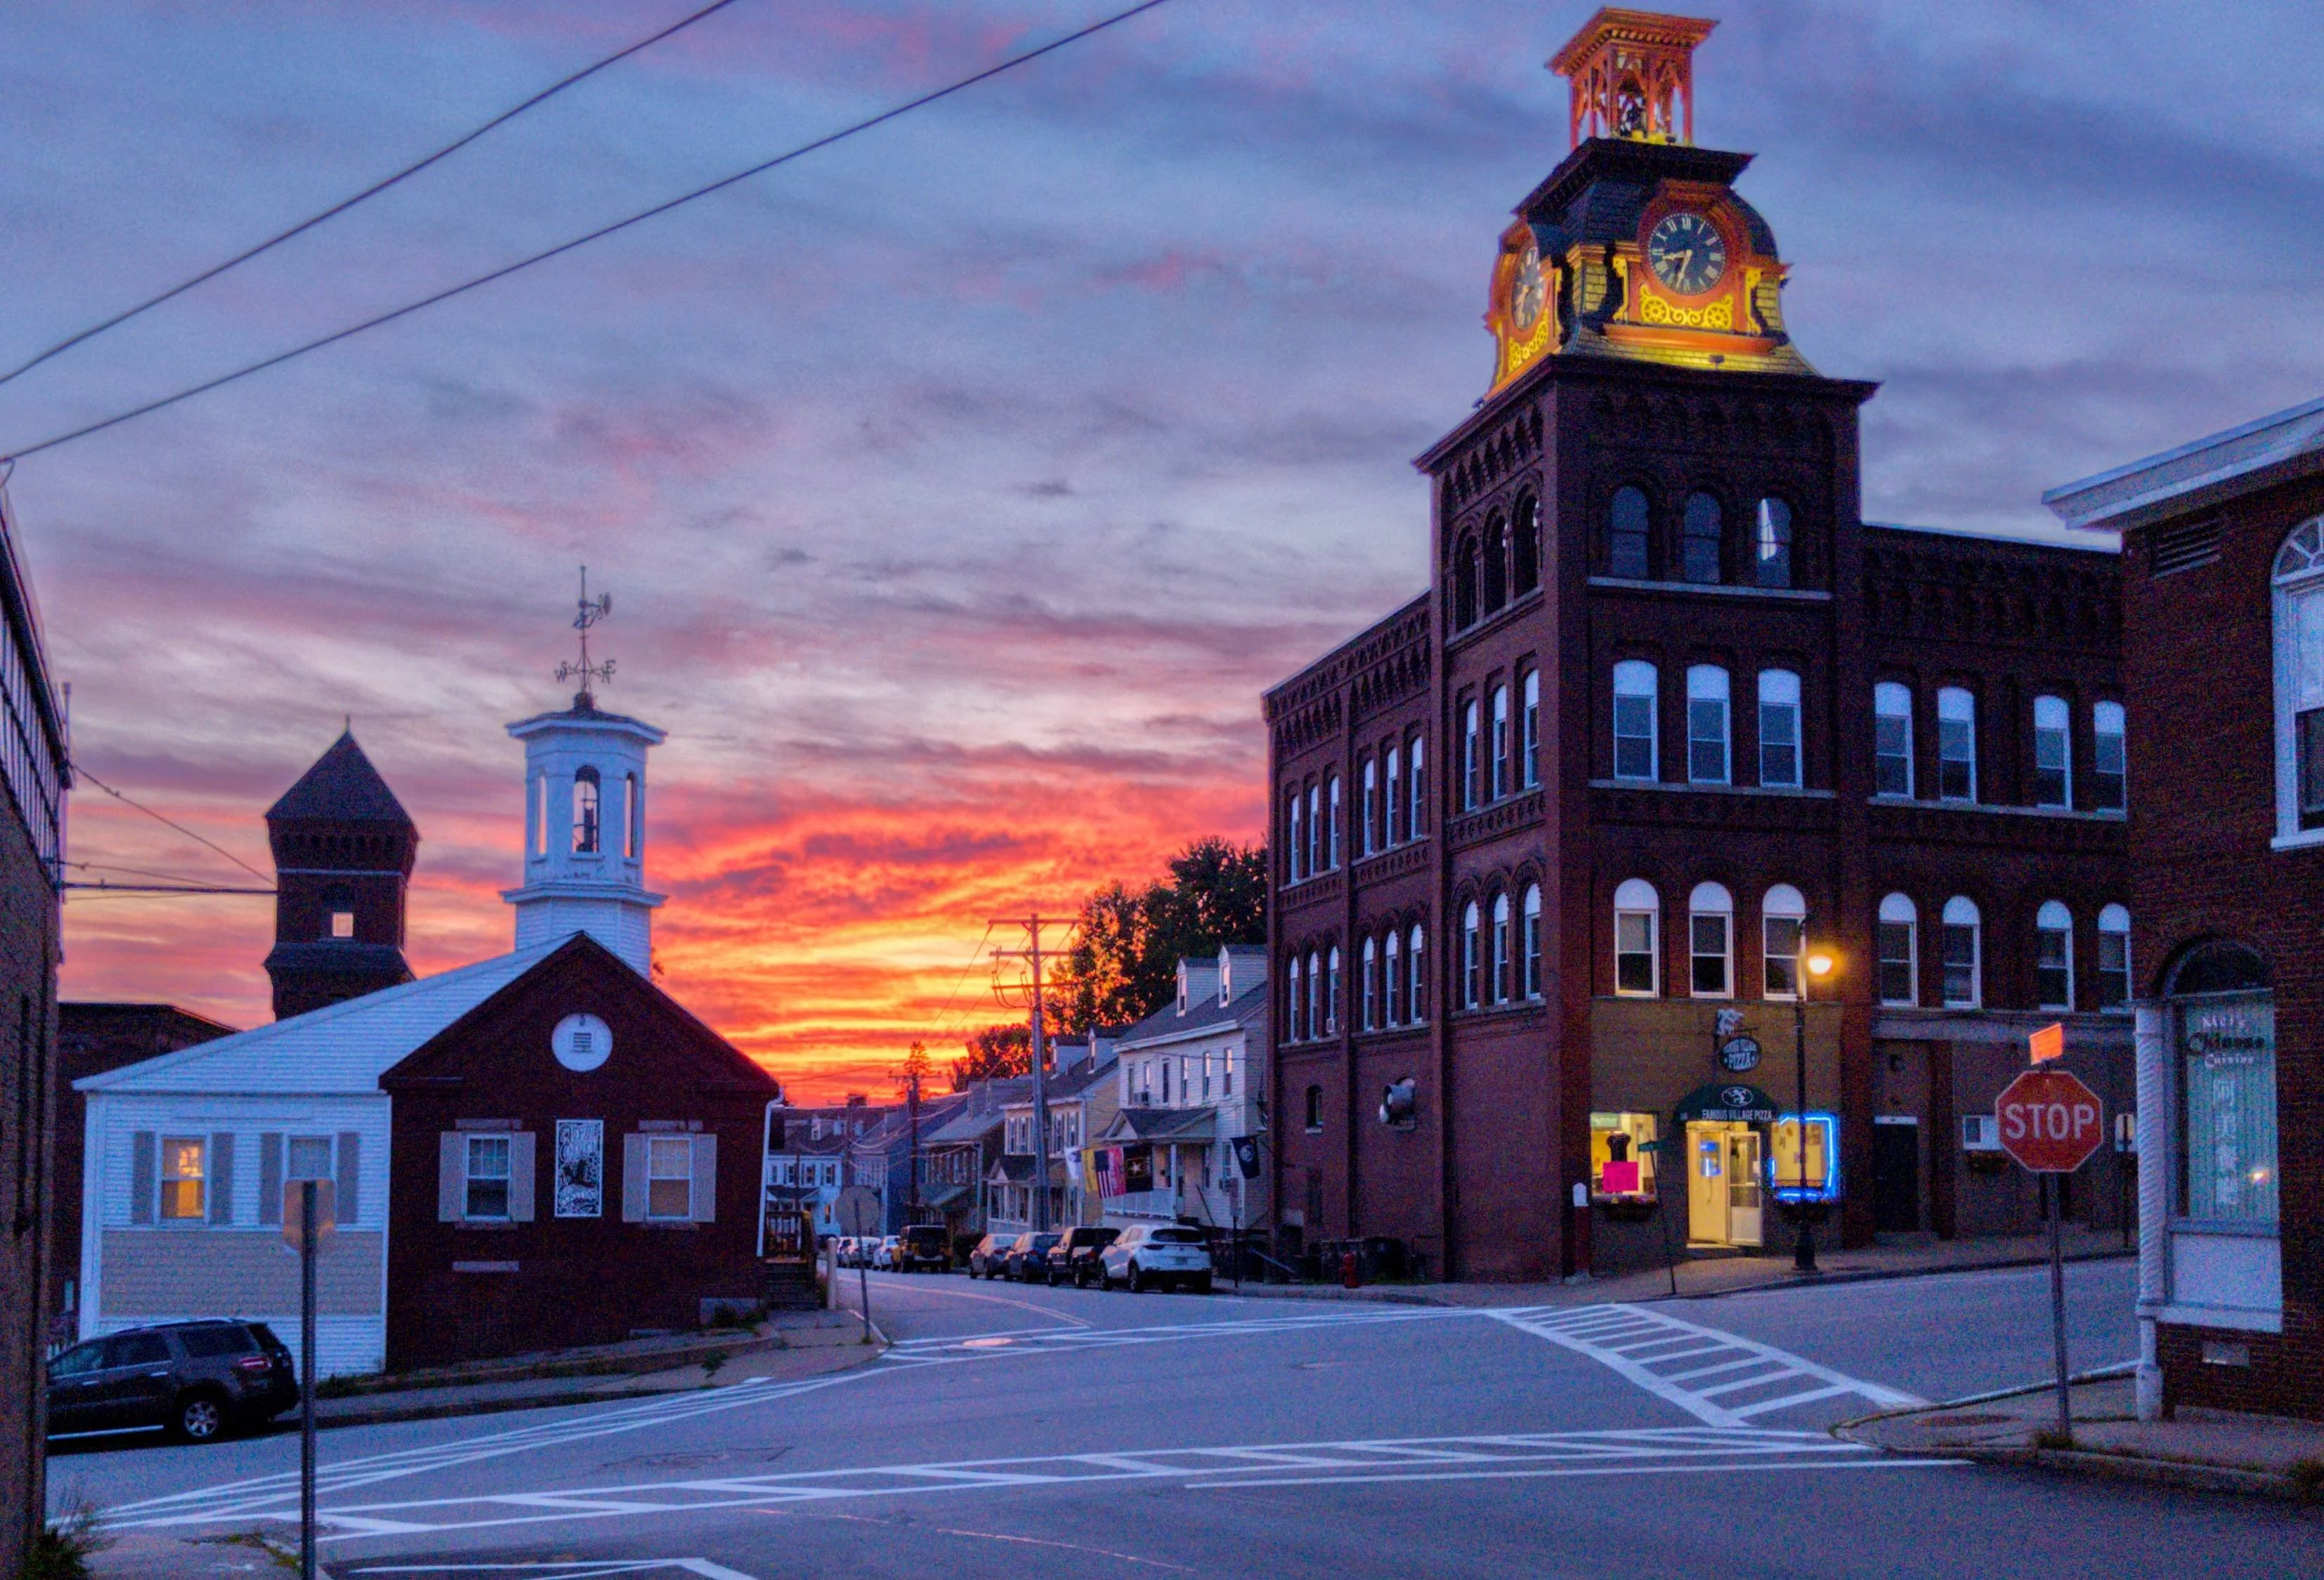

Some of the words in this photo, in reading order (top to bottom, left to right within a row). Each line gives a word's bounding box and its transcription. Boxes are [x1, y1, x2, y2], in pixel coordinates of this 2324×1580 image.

[1728, 1052, 1751, 1070] PIZZA
[1702, 1109, 1728, 1121] FAMOUS
[1728, 1109, 1754, 1121] VILLAGE
[1754, 1109, 1773, 1121] PIZZA
[2006, 1103, 2095, 1140] STOP
